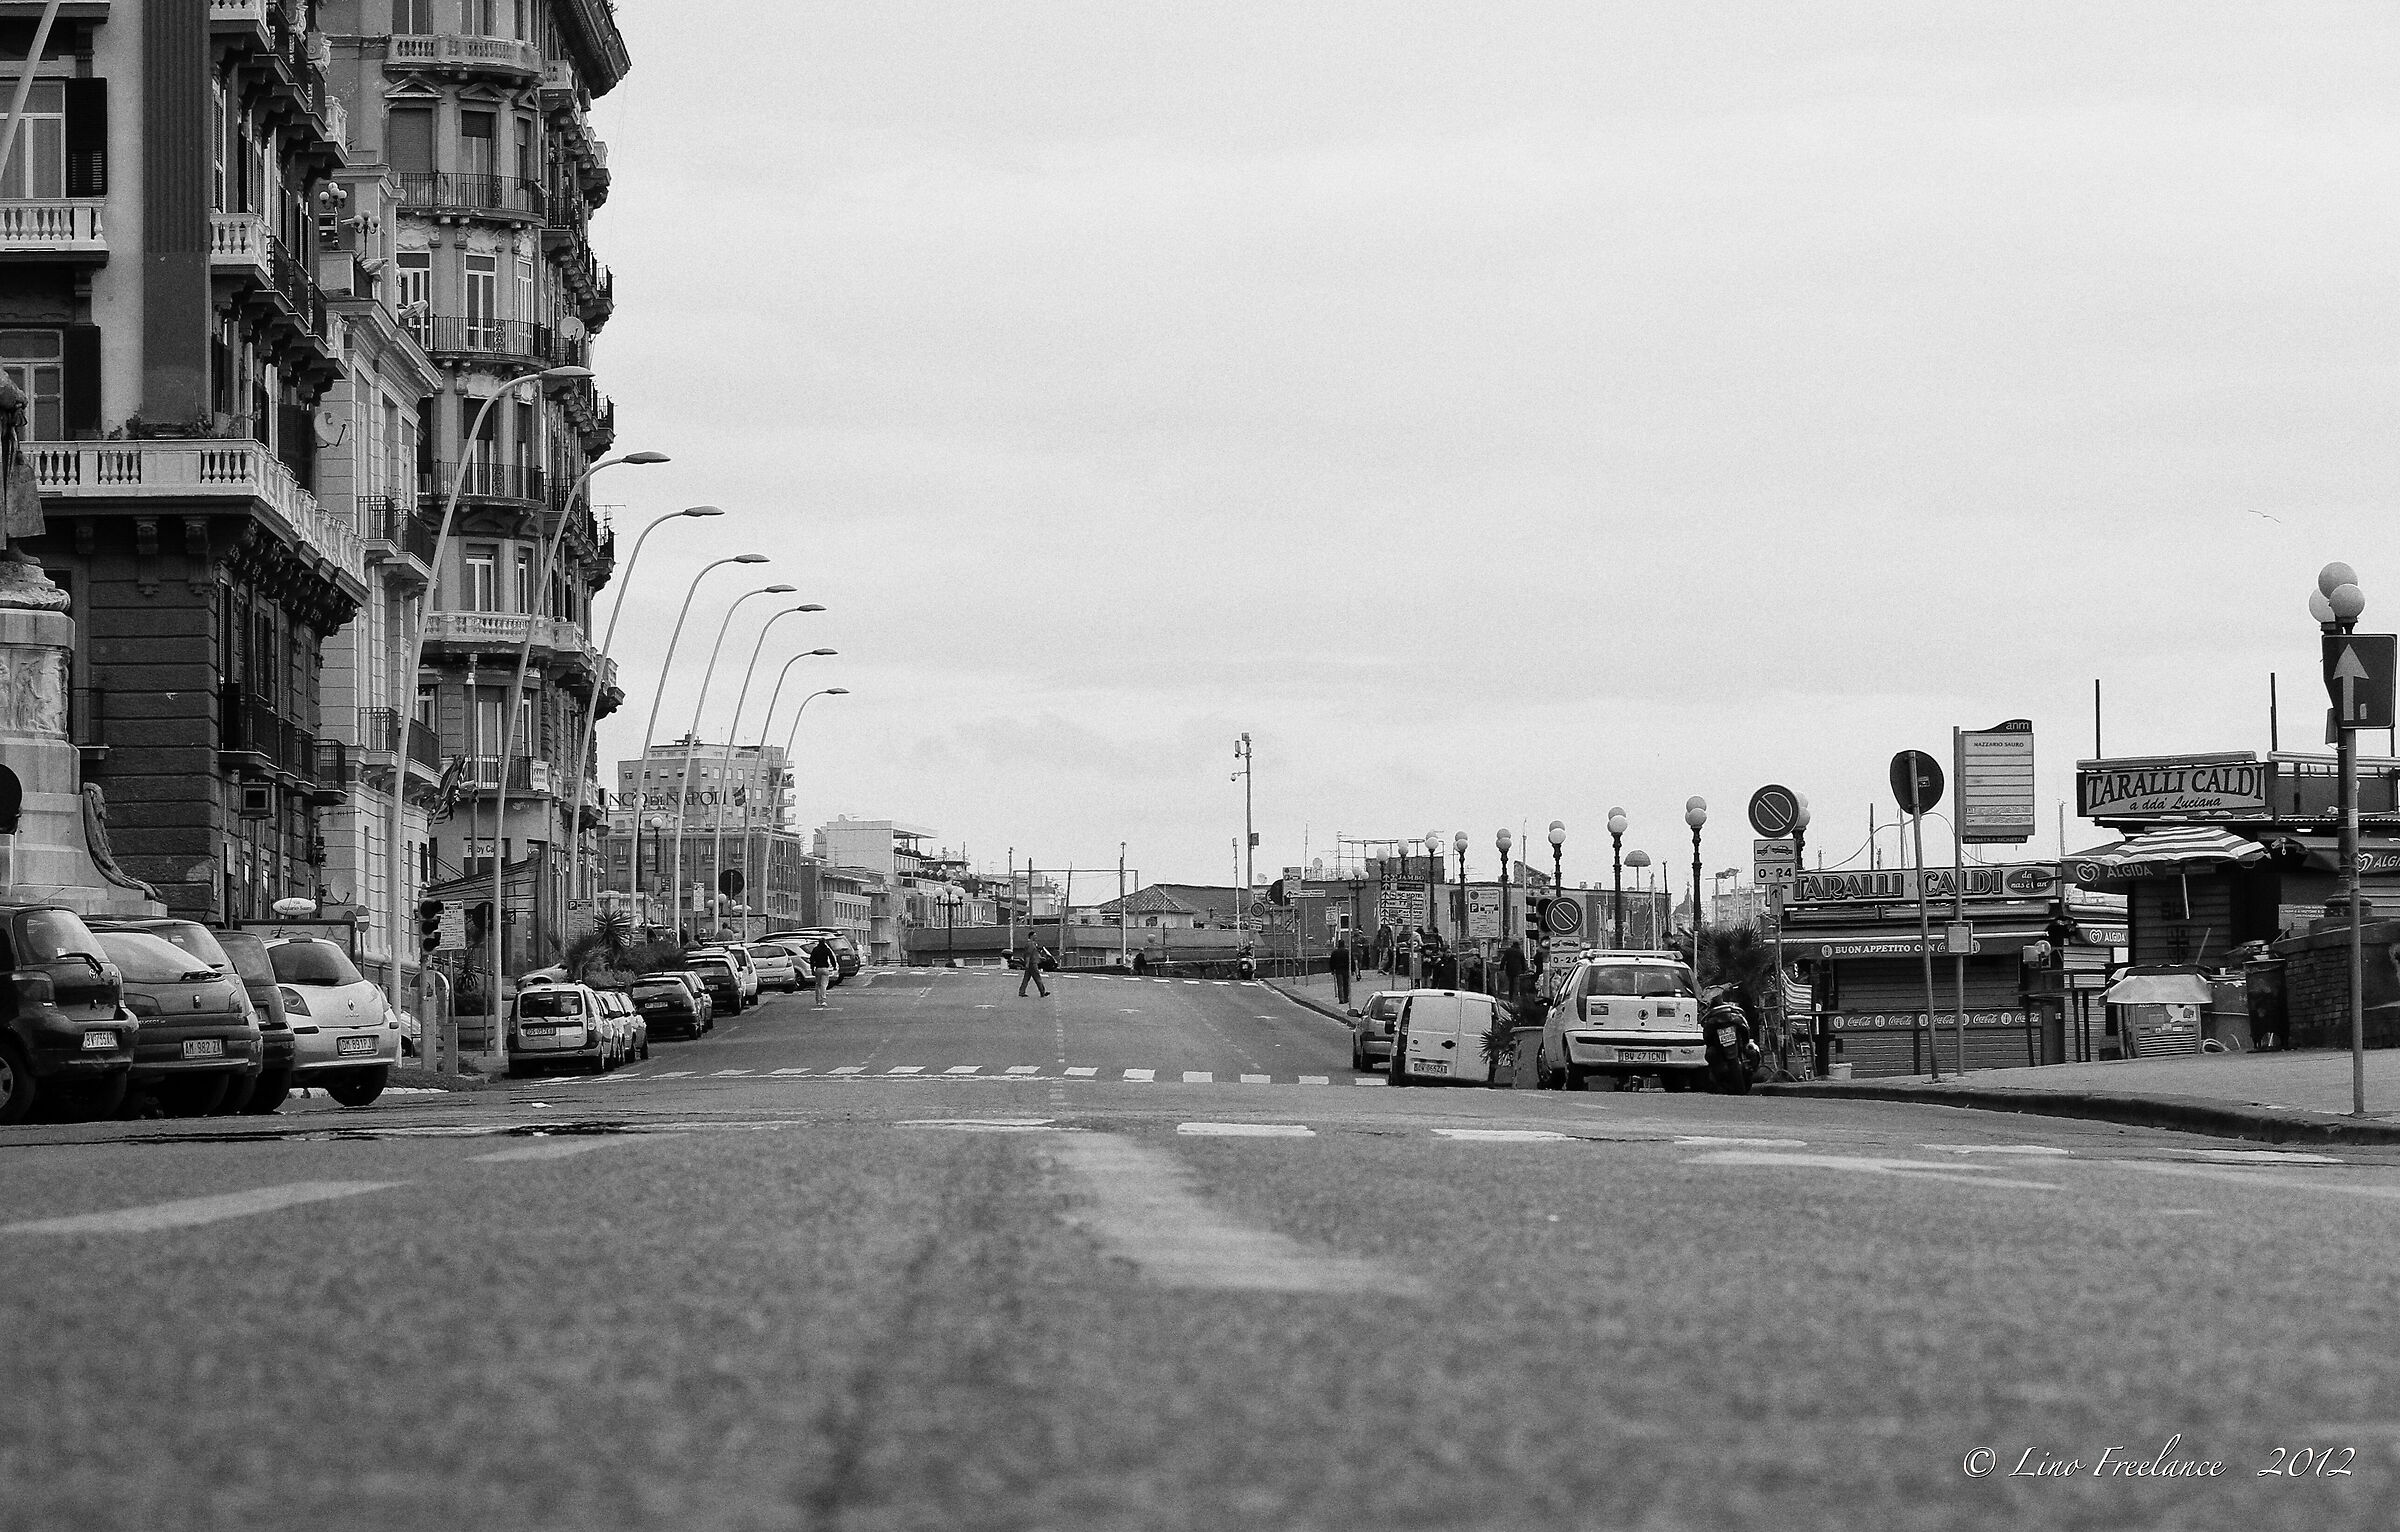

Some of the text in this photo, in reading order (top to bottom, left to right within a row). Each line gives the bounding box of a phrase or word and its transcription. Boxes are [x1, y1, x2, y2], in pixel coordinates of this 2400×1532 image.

[2005, 721, 2029, 730] anm
[2087, 767, 2263, 810] TARALLI CALDI
[2129, 802, 2138, 810] a
[2170, 795, 2222, 810] Luciana
[2106, 864, 2153, 878] ALGIDA
[1793, 869, 2003, 901] TARALLI CALDI
[2104, 932, 2126, 942] ALGIDA
[1835, 945, 1861, 954] BUON
[1863, 944, 1911, 953] APPETITO
